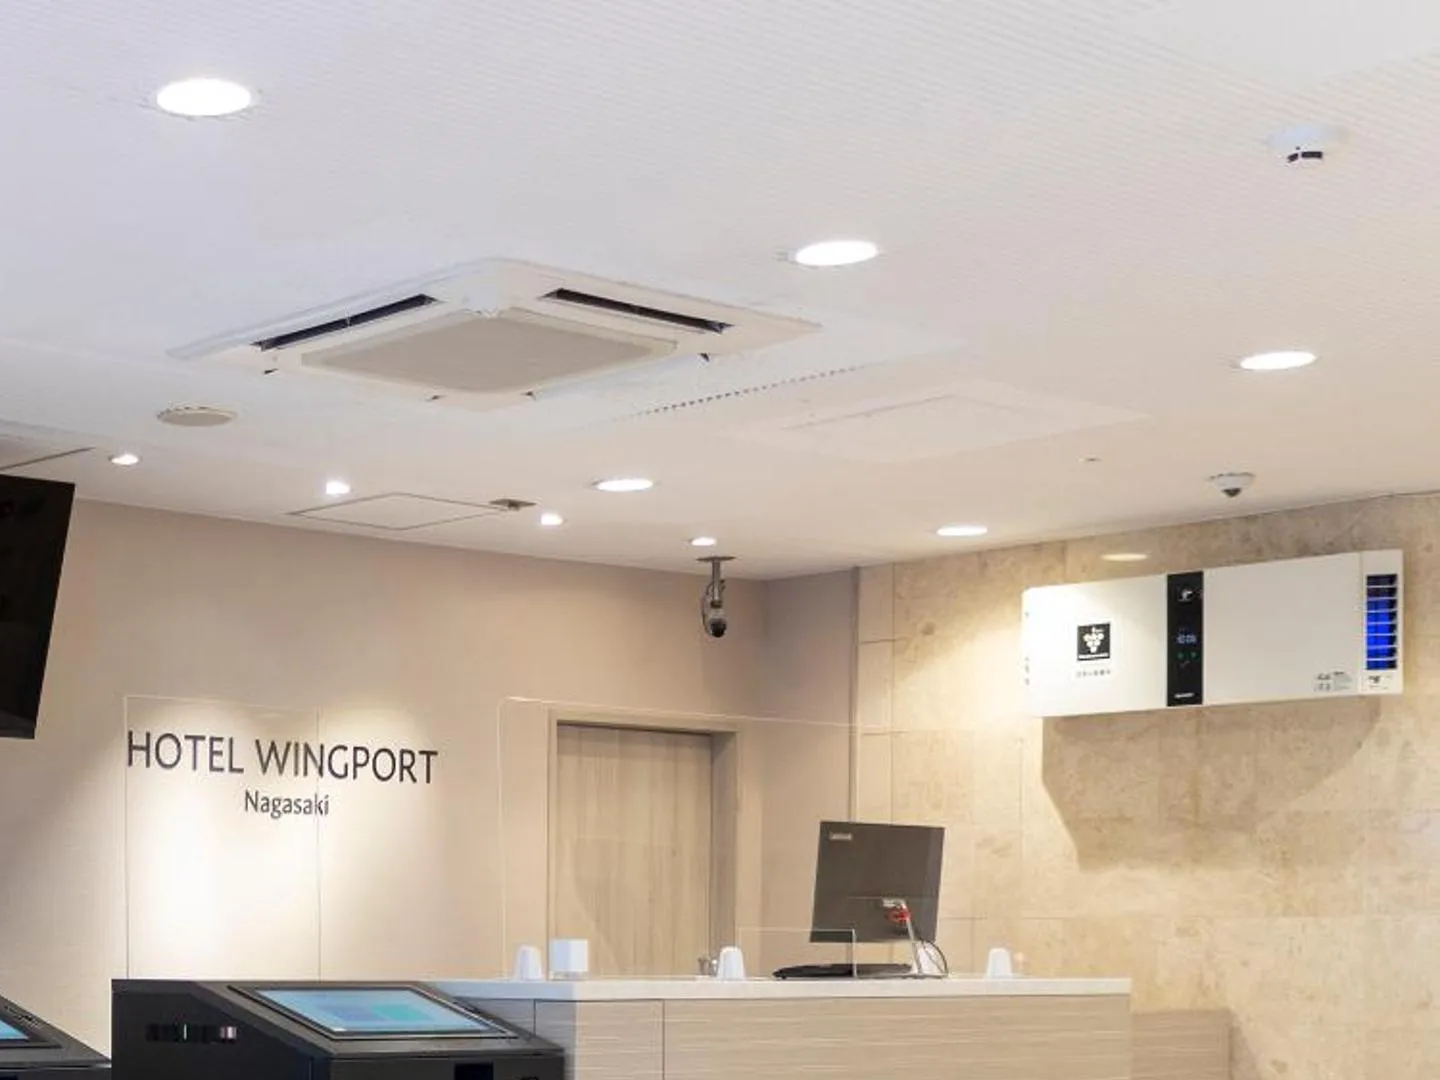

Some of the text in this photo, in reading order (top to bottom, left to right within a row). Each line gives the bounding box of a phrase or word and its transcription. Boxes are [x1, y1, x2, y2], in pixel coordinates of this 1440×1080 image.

[127, 730, 438, 784] HOTEL WINGPORT
[244, 789, 329, 819] Nagasaki
